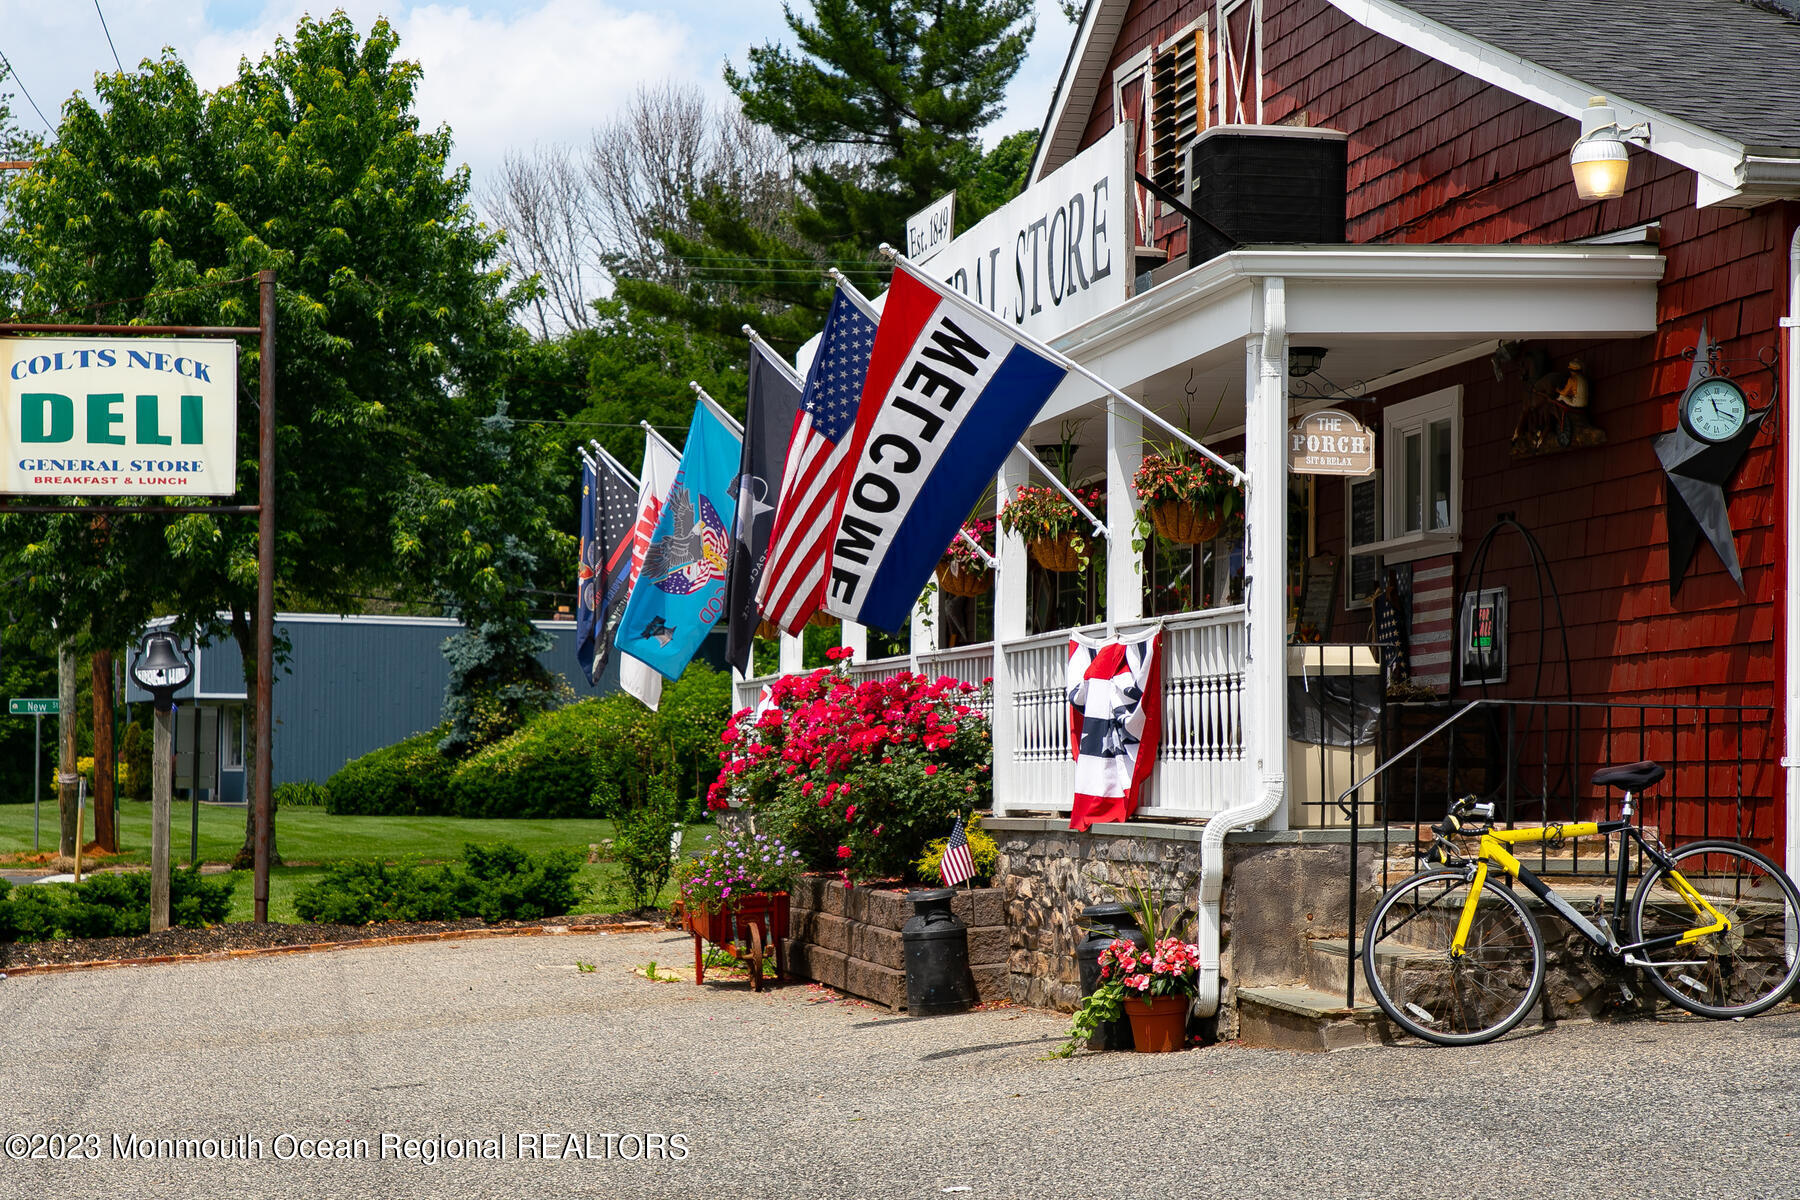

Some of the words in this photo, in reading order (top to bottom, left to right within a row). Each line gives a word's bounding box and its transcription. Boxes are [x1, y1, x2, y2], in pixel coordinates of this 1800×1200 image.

[910, 226, 927, 259] Est.
[930, 206, 948, 247] 1849
[1015, 175, 1111, 325] STORE
[11, 348, 117, 380] COLTS
[126, 350, 212, 384] NECK
[21, 393, 203, 446] DELI
[1317, 417, 1342, 431] THE
[1292, 434, 1366, 454] PORCH
[19, 459, 124, 472] GENERAL
[130, 460, 204, 473] STORE
[34, 476, 118, 485] BREAKFAST
[124, 477, 133, 485] &
[139, 477, 188, 485] LUNCH
[27, 701, 47, 712] New
